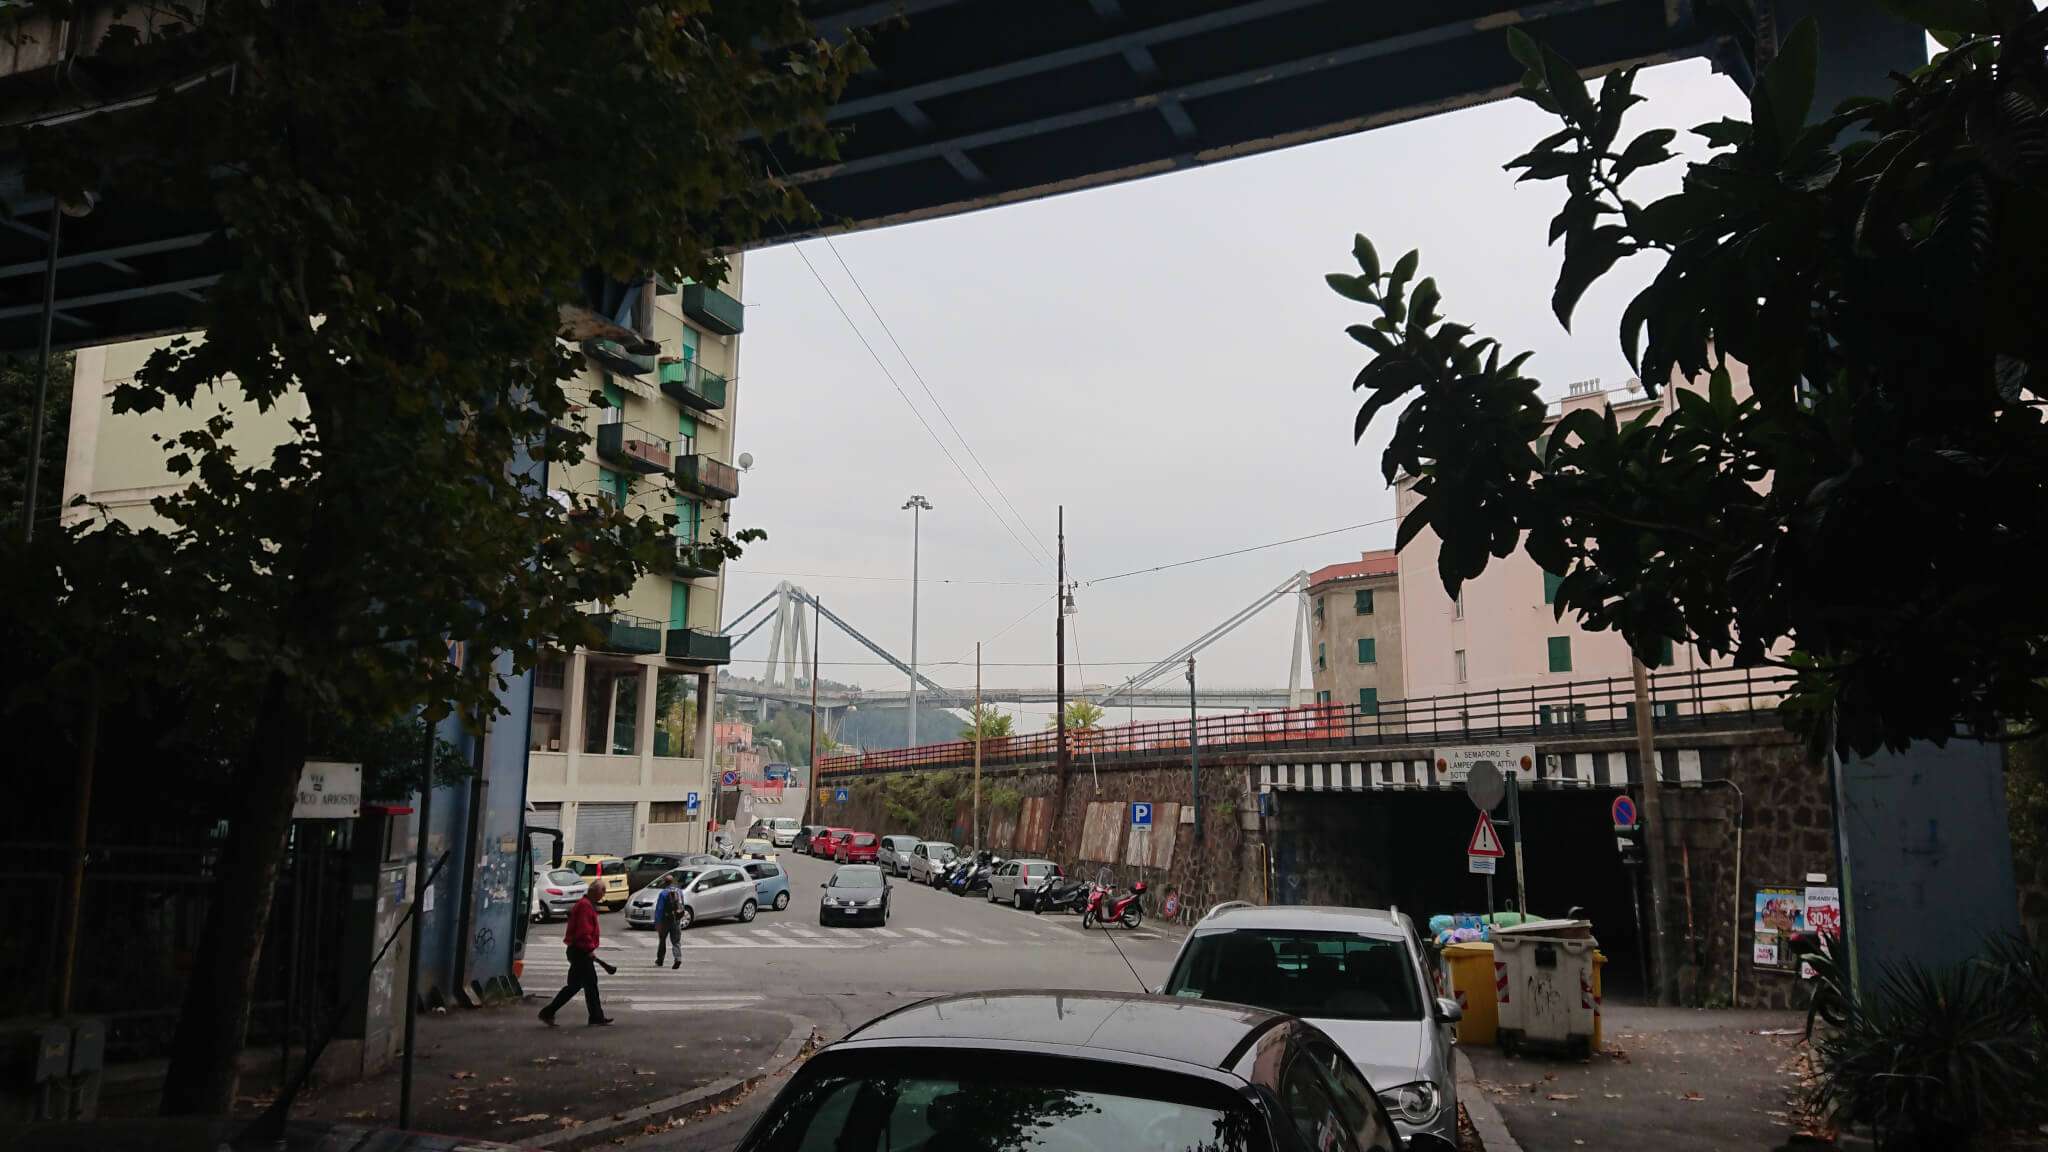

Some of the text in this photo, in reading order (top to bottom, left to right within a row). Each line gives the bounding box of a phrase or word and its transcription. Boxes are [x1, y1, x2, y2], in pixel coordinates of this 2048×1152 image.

[1464, 750, 1501, 759] SEMAFORO
[310, 775, 324, 783] VIA
[322, 792, 360, 805] ARIOSTO
[1135, 805, 1148, 823] P
